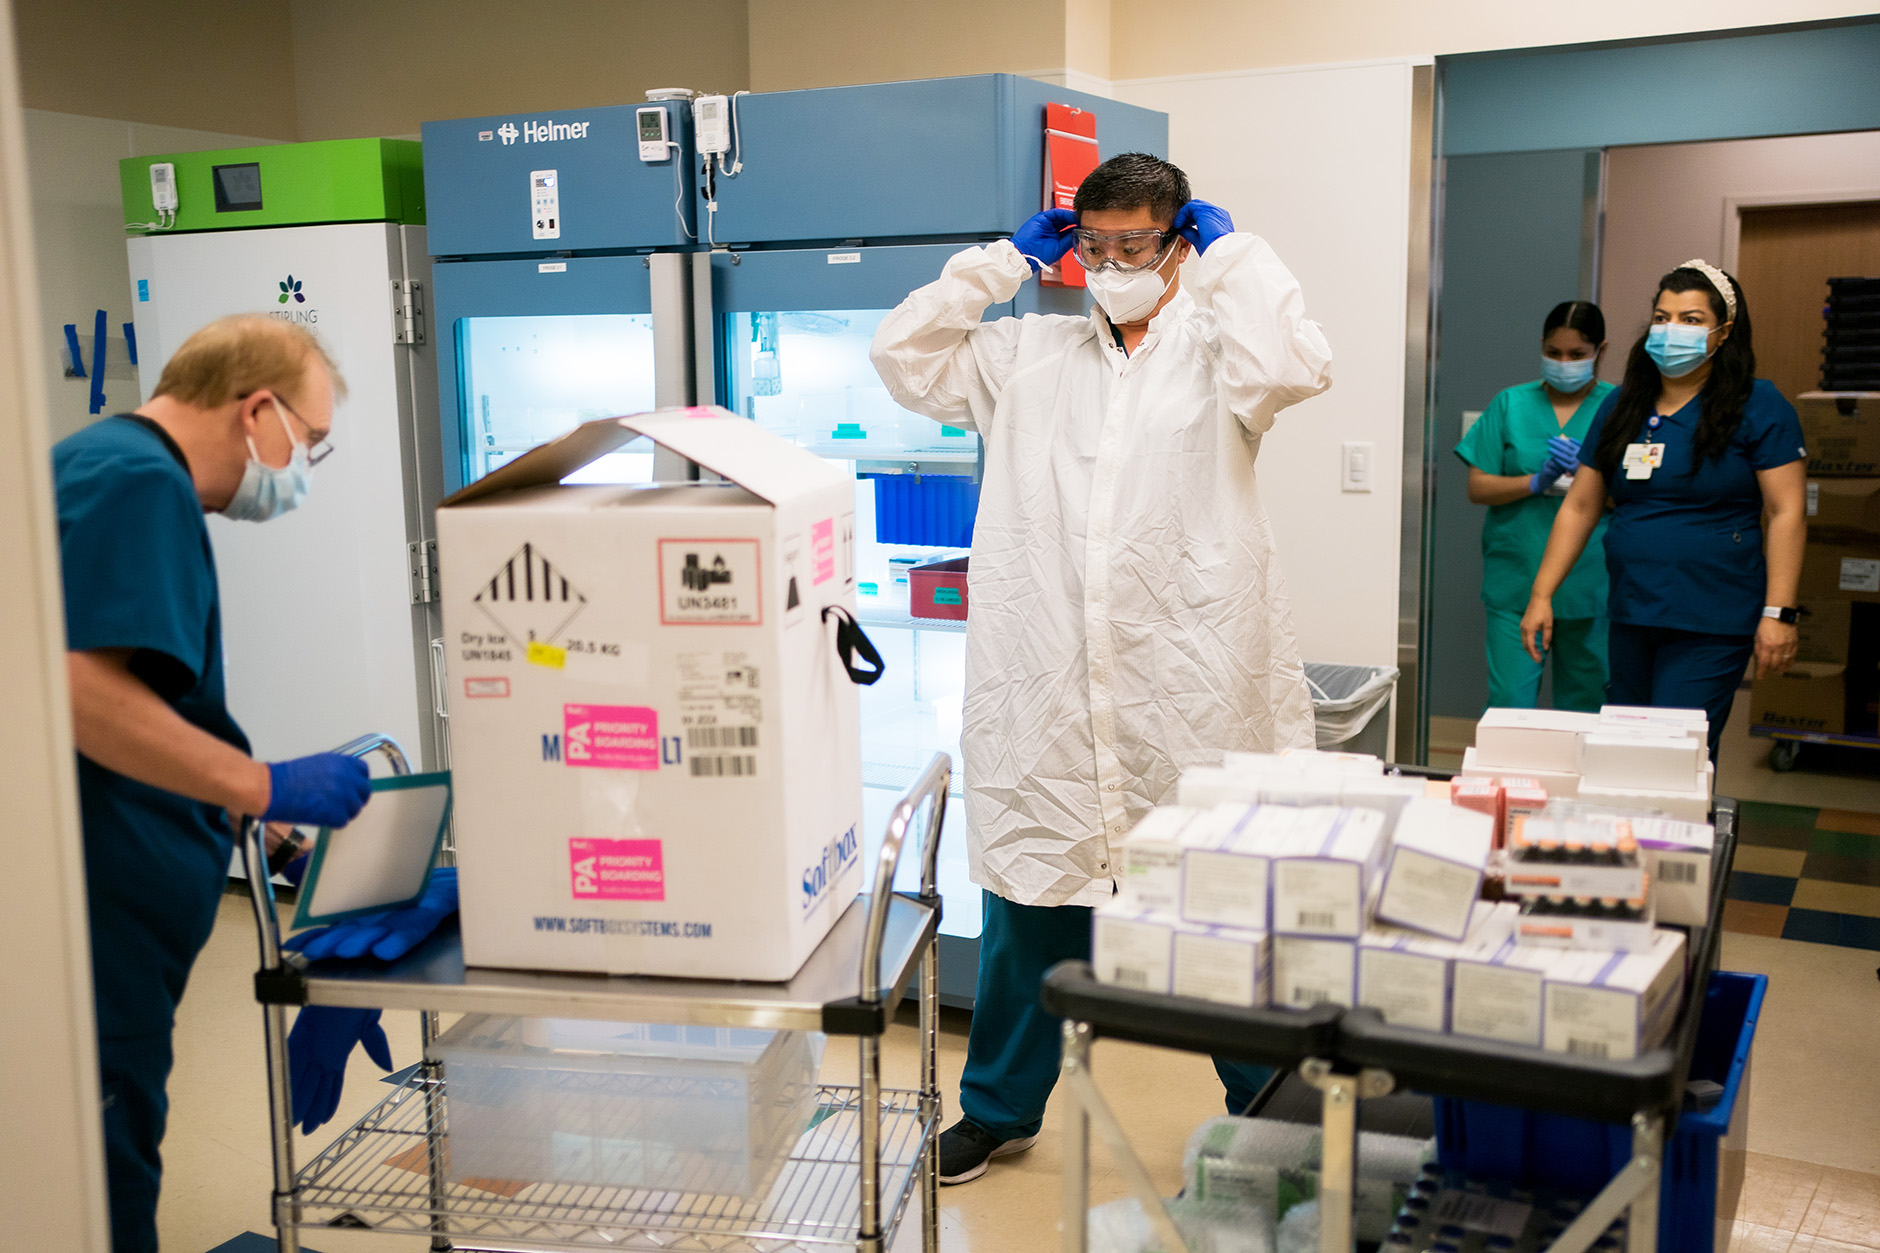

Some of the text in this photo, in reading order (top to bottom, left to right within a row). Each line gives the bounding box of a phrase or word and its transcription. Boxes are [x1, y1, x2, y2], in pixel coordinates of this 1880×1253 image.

[523, 120, 590, 143] Helmer
[1806, 459, 1874, 472] Baxter
[678, 597, 738, 610] UN3481
[461, 632, 484, 646] Dry
[601, 643, 622, 656] KG
[593, 721, 649, 735] PRIORITY
[567, 722, 592, 760] PA
[593, 736, 657, 750] BOARDING
[600, 856, 653, 868] PRIORITY
[573, 856, 598, 893] PA
[600, 870, 662, 882] BOARDING
